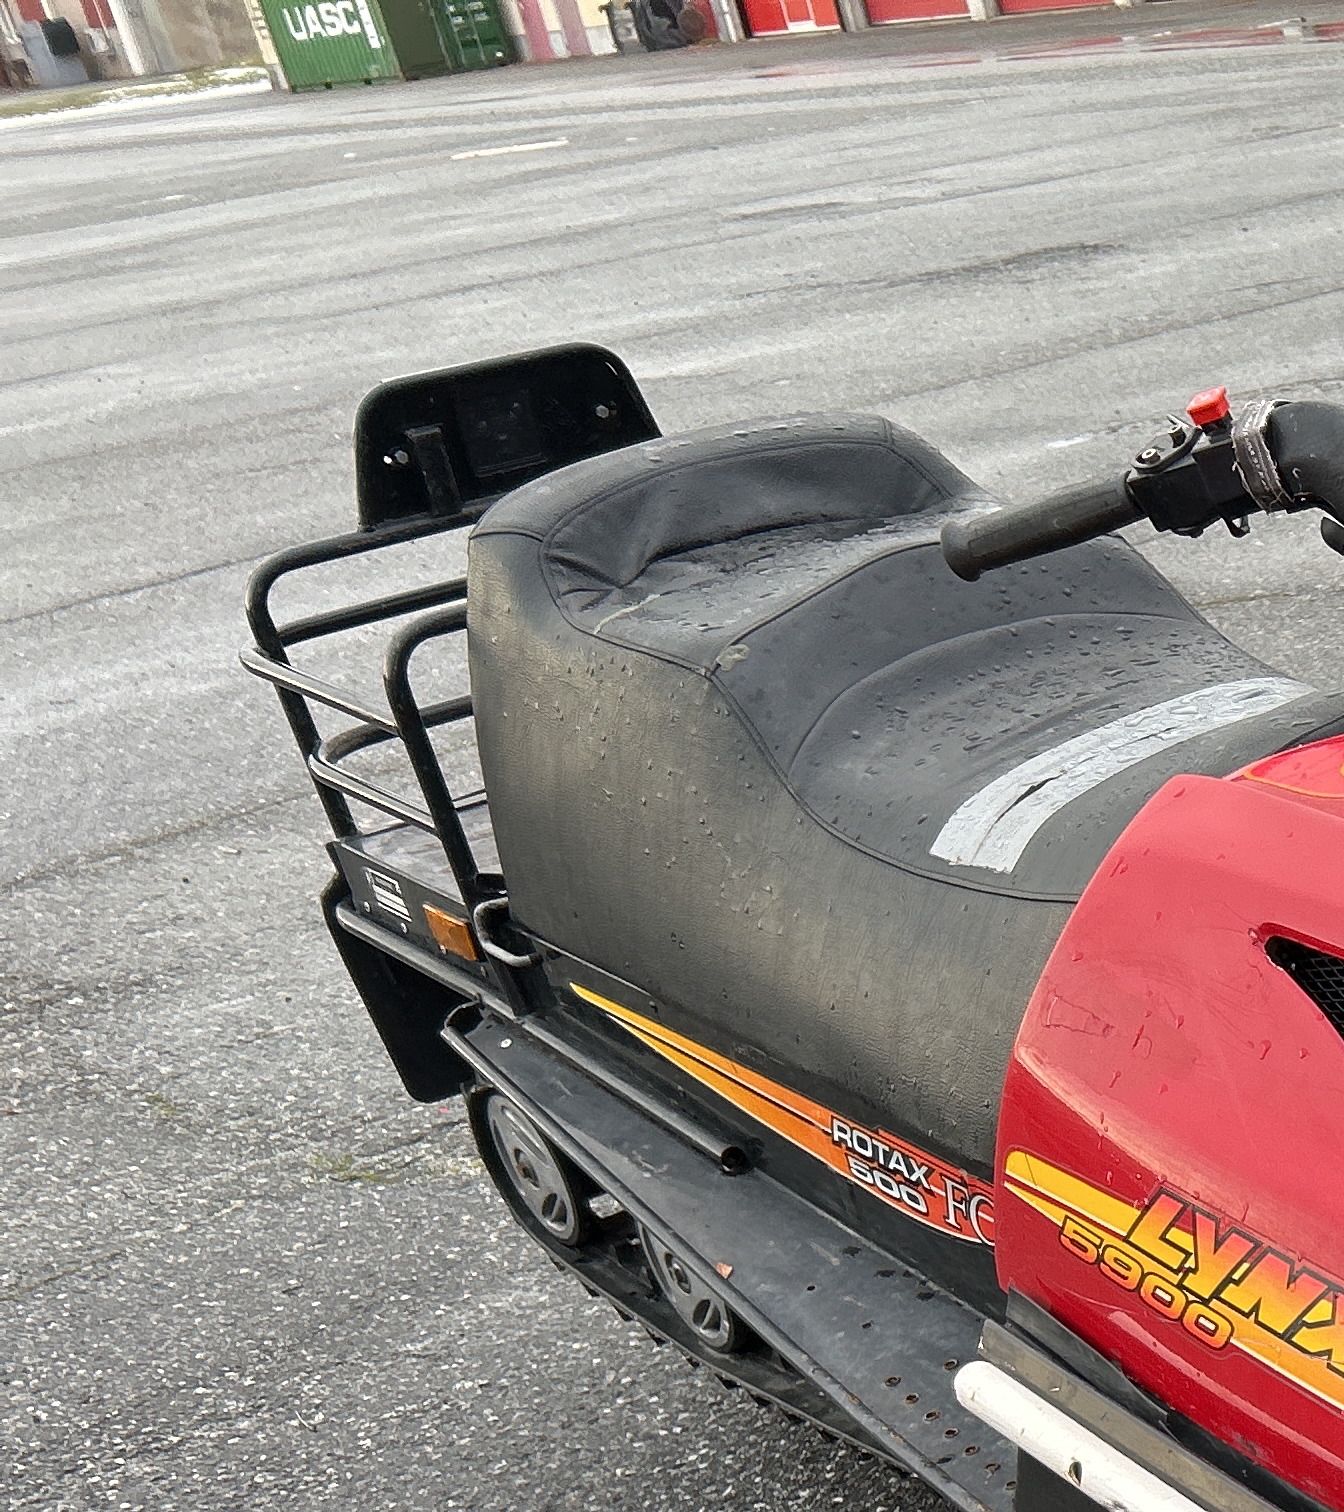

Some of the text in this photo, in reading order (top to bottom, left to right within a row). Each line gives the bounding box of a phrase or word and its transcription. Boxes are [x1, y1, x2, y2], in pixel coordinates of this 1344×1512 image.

[282, 1, 362, 41] UASC
[831, 1116, 935, 1197] ROTAX
[846, 1153, 928, 1215] 500
[1059, 1214, 1234, 1350] 5900
